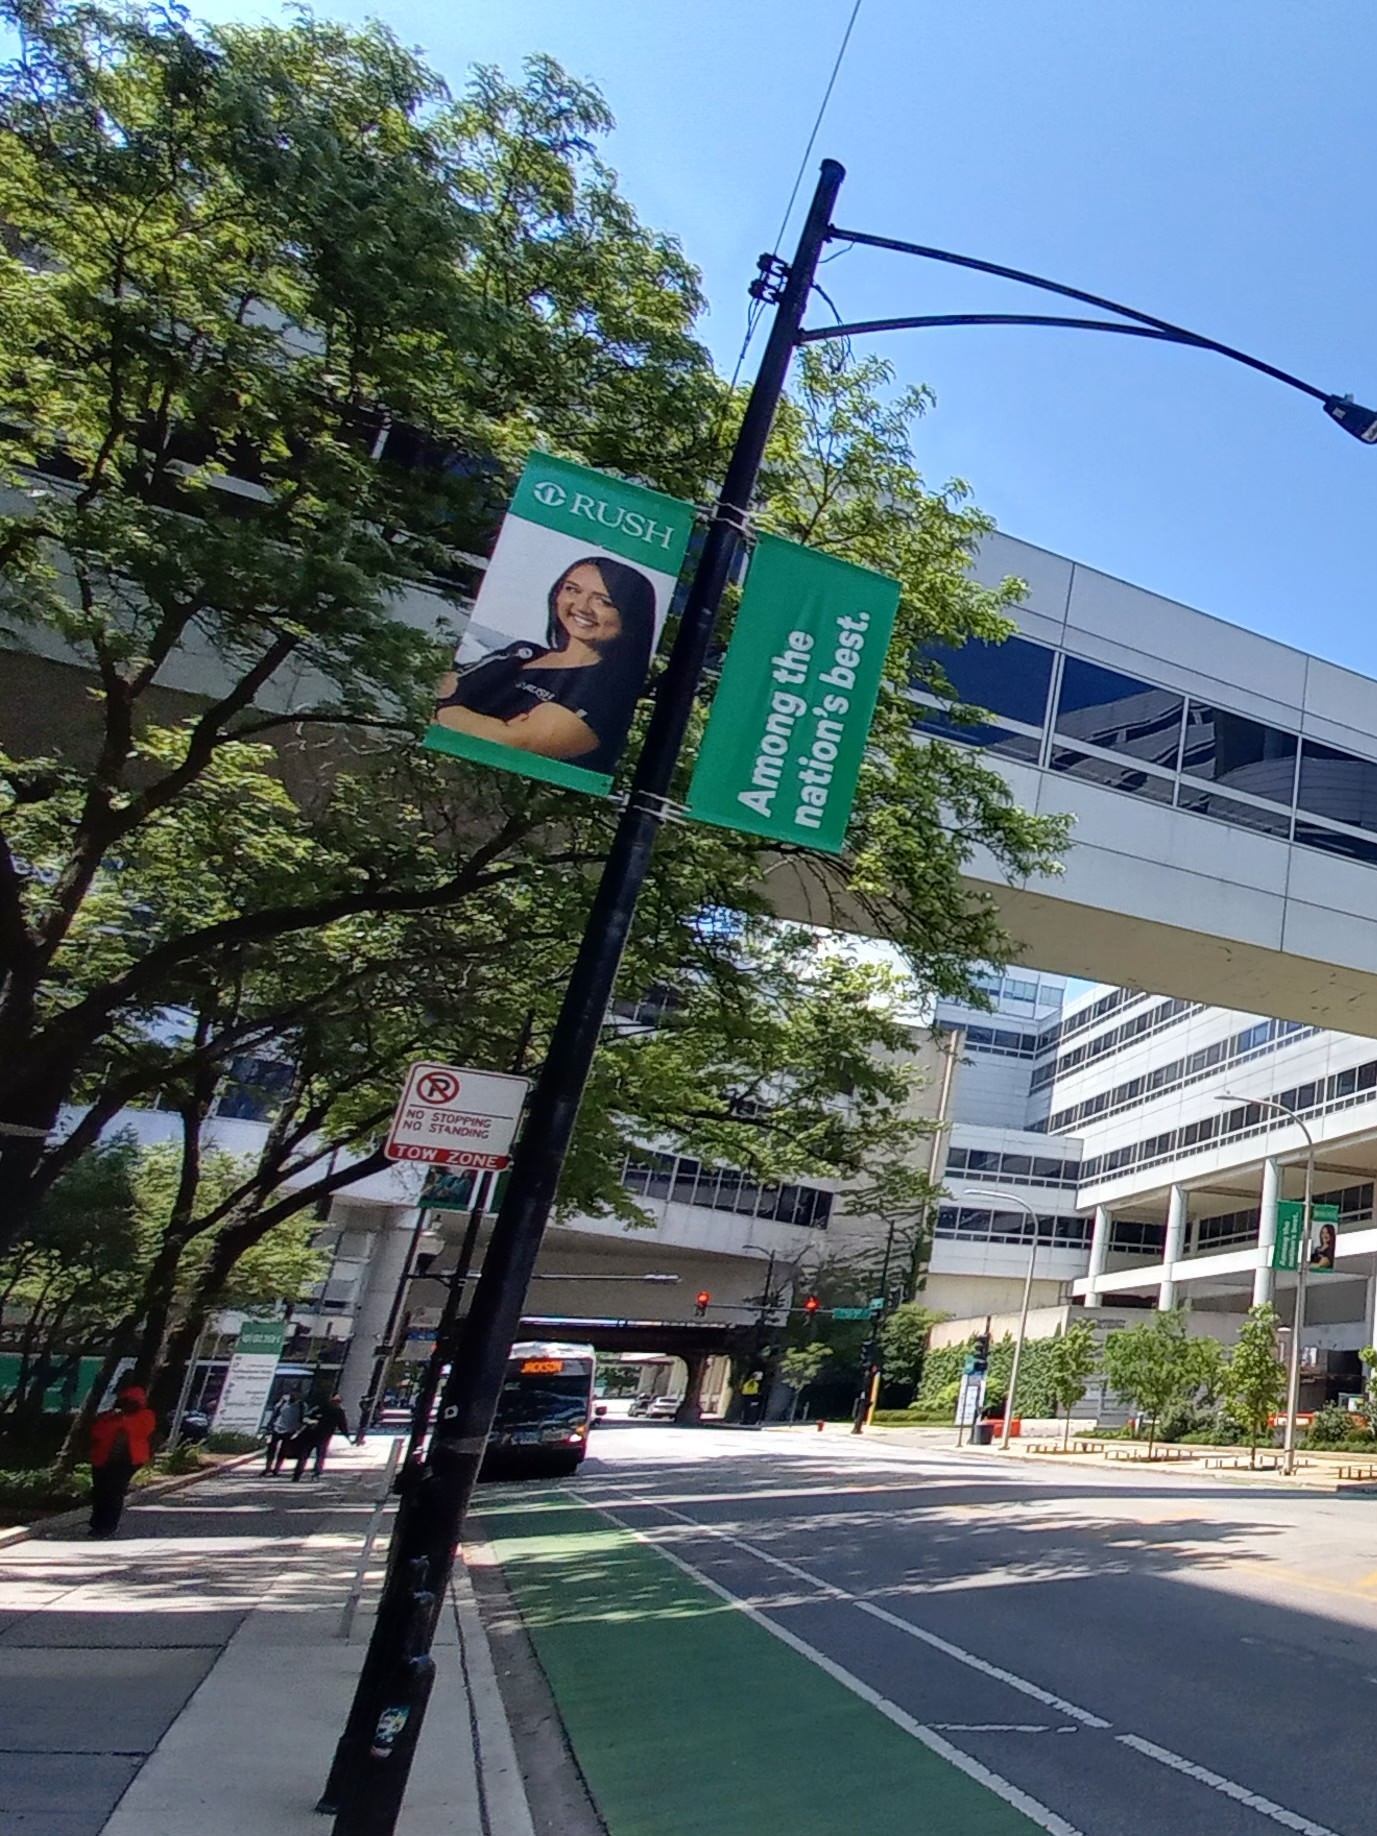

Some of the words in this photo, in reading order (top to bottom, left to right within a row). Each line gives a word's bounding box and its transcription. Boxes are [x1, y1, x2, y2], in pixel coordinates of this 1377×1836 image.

[569, 492, 675, 550] RUSH
[771, 630, 814, 684] the
[818, 611, 871, 690] best.
[737, 691, 808, 818] Among
[794, 694, 849, 829] nation's
[402, 1121, 422, 1131] NO
[428, 1123, 489, 1139] STANDING
[406, 1109, 425, 1120] NO
[431, 1112, 492, 1129] STOPPING
[396, 1145, 438, 1160] TOW
[446, 1151, 499, 1168] ZONE
